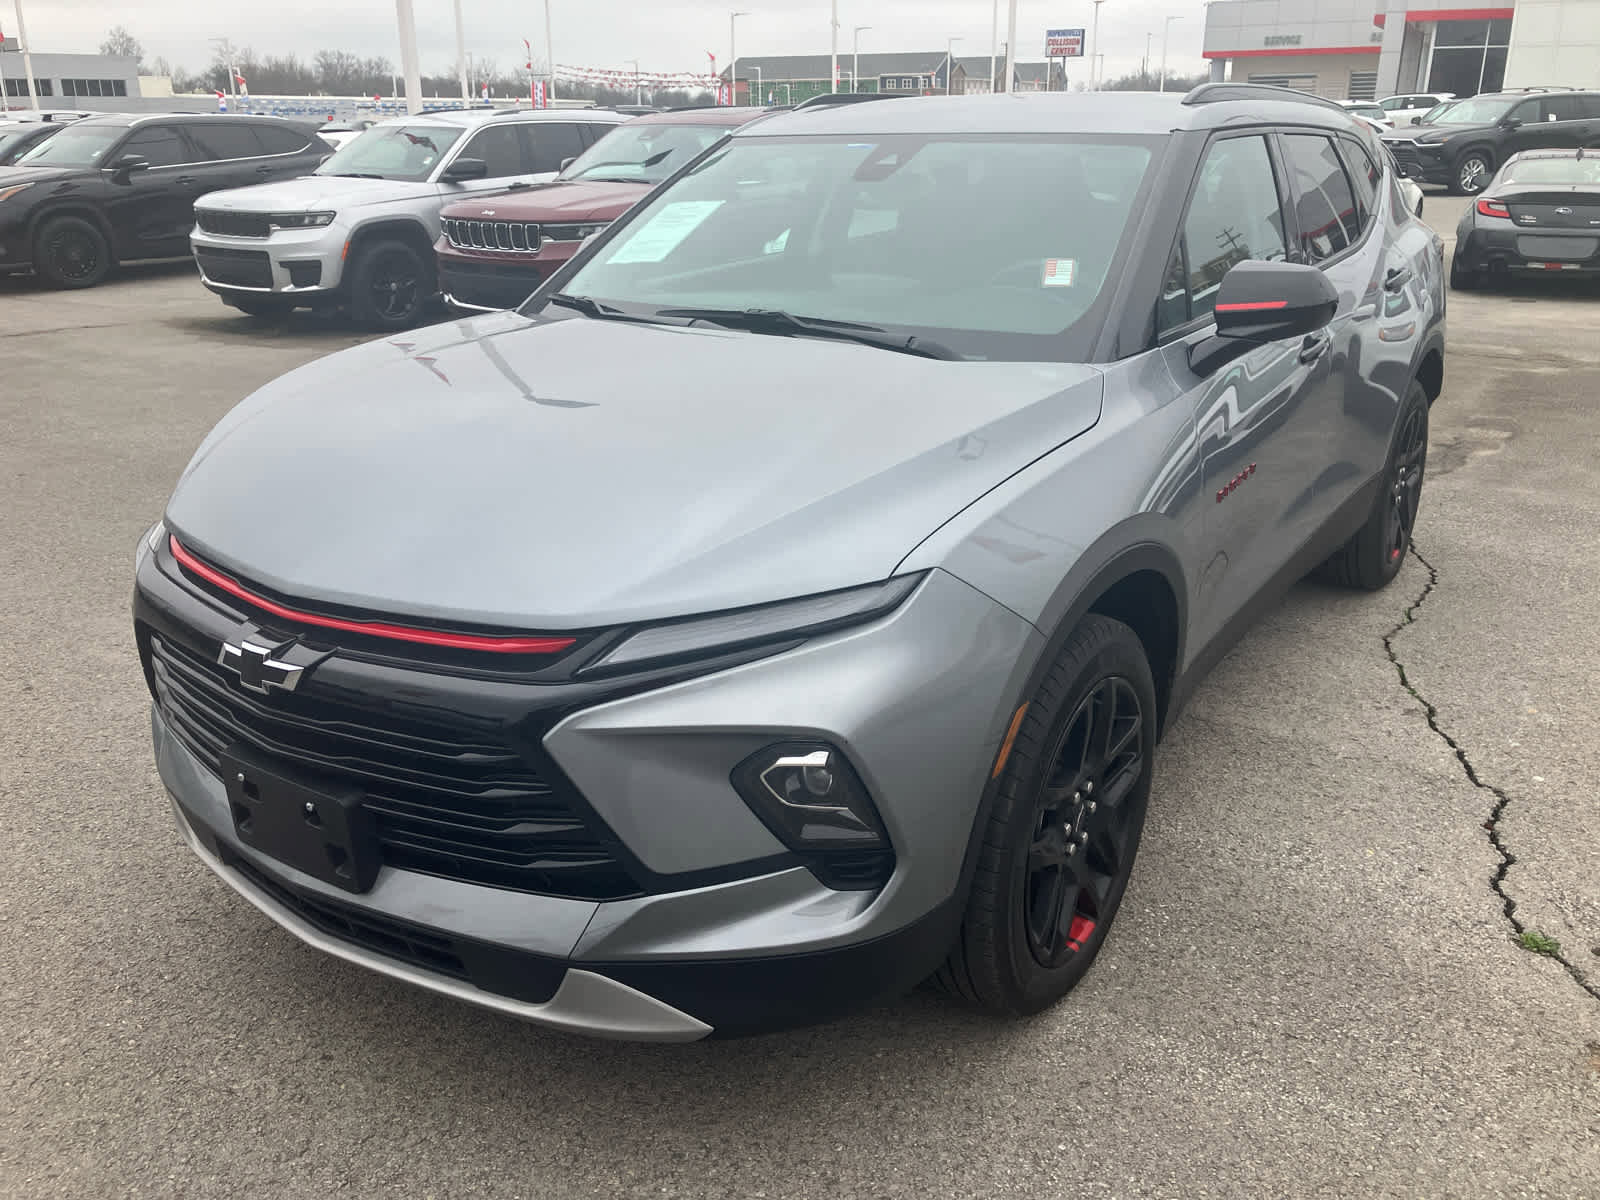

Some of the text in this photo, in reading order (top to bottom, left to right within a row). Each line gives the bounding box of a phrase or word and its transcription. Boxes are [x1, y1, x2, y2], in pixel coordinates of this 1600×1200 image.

[1047, 37, 1081, 46] COLLISION
[1264, 35, 1302, 47] SERVICE
[1050, 47, 1077, 55] CENTER
